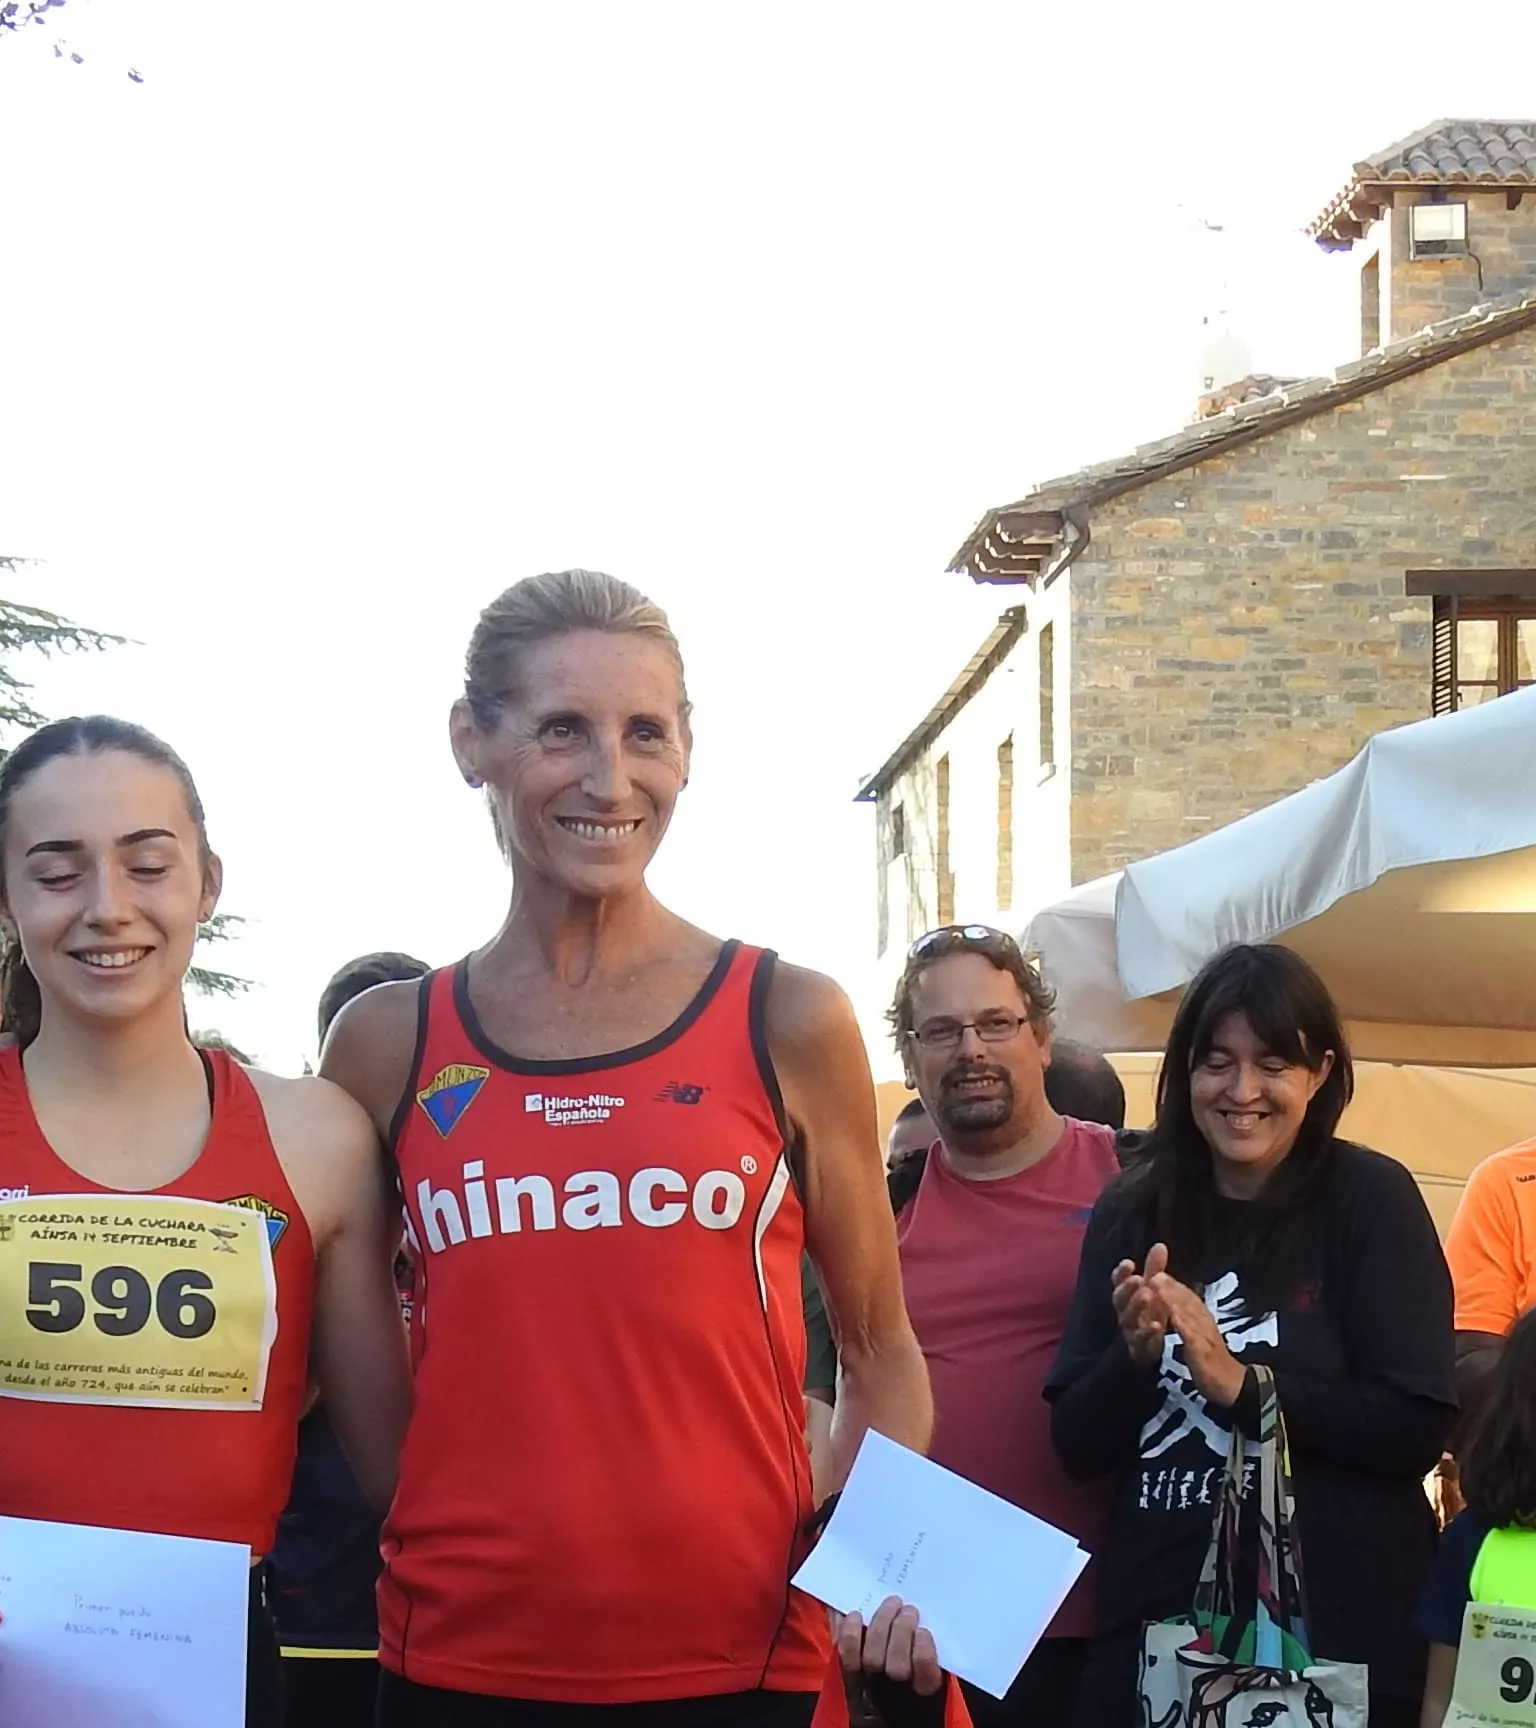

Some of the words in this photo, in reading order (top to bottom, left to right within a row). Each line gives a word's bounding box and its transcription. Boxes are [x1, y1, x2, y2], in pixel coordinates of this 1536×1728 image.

[545, 1094, 624, 1110] Hidro-Nitro
[545, 1107, 610, 1124] Española
[417, 1160, 746, 1254] hinaco
[18, 1213, 85, 1225] CORRIDA
[90, 1215, 108, 1226] DE
[113, 1216, 133, 1227] LA
[138, 1218, 206, 1233] CUCHARA
[30, 1226, 78, 1242] AÍNSA
[102, 1232, 198, 1249] SEPTIEMBRE
[26, 1261, 217, 1340] 596
[16, 1357, 30, 1369] de
[35, 1359, 50, 1371] las
[54, 1363, 103, 1374] carreras
[107, 1364, 131, 1375] más
[135, 1365, 184, 1379] antiguas
[187, 1366, 205, 1378] del
[4, 1373, 36, 1386] desde
[40, 1376, 51, 1387] el
[54, 1376, 76, 1388] año
[81, 1378, 110, 1390] 724,
[114, 1381, 134, 1393] que
[164, 1383, 176, 1393] se
